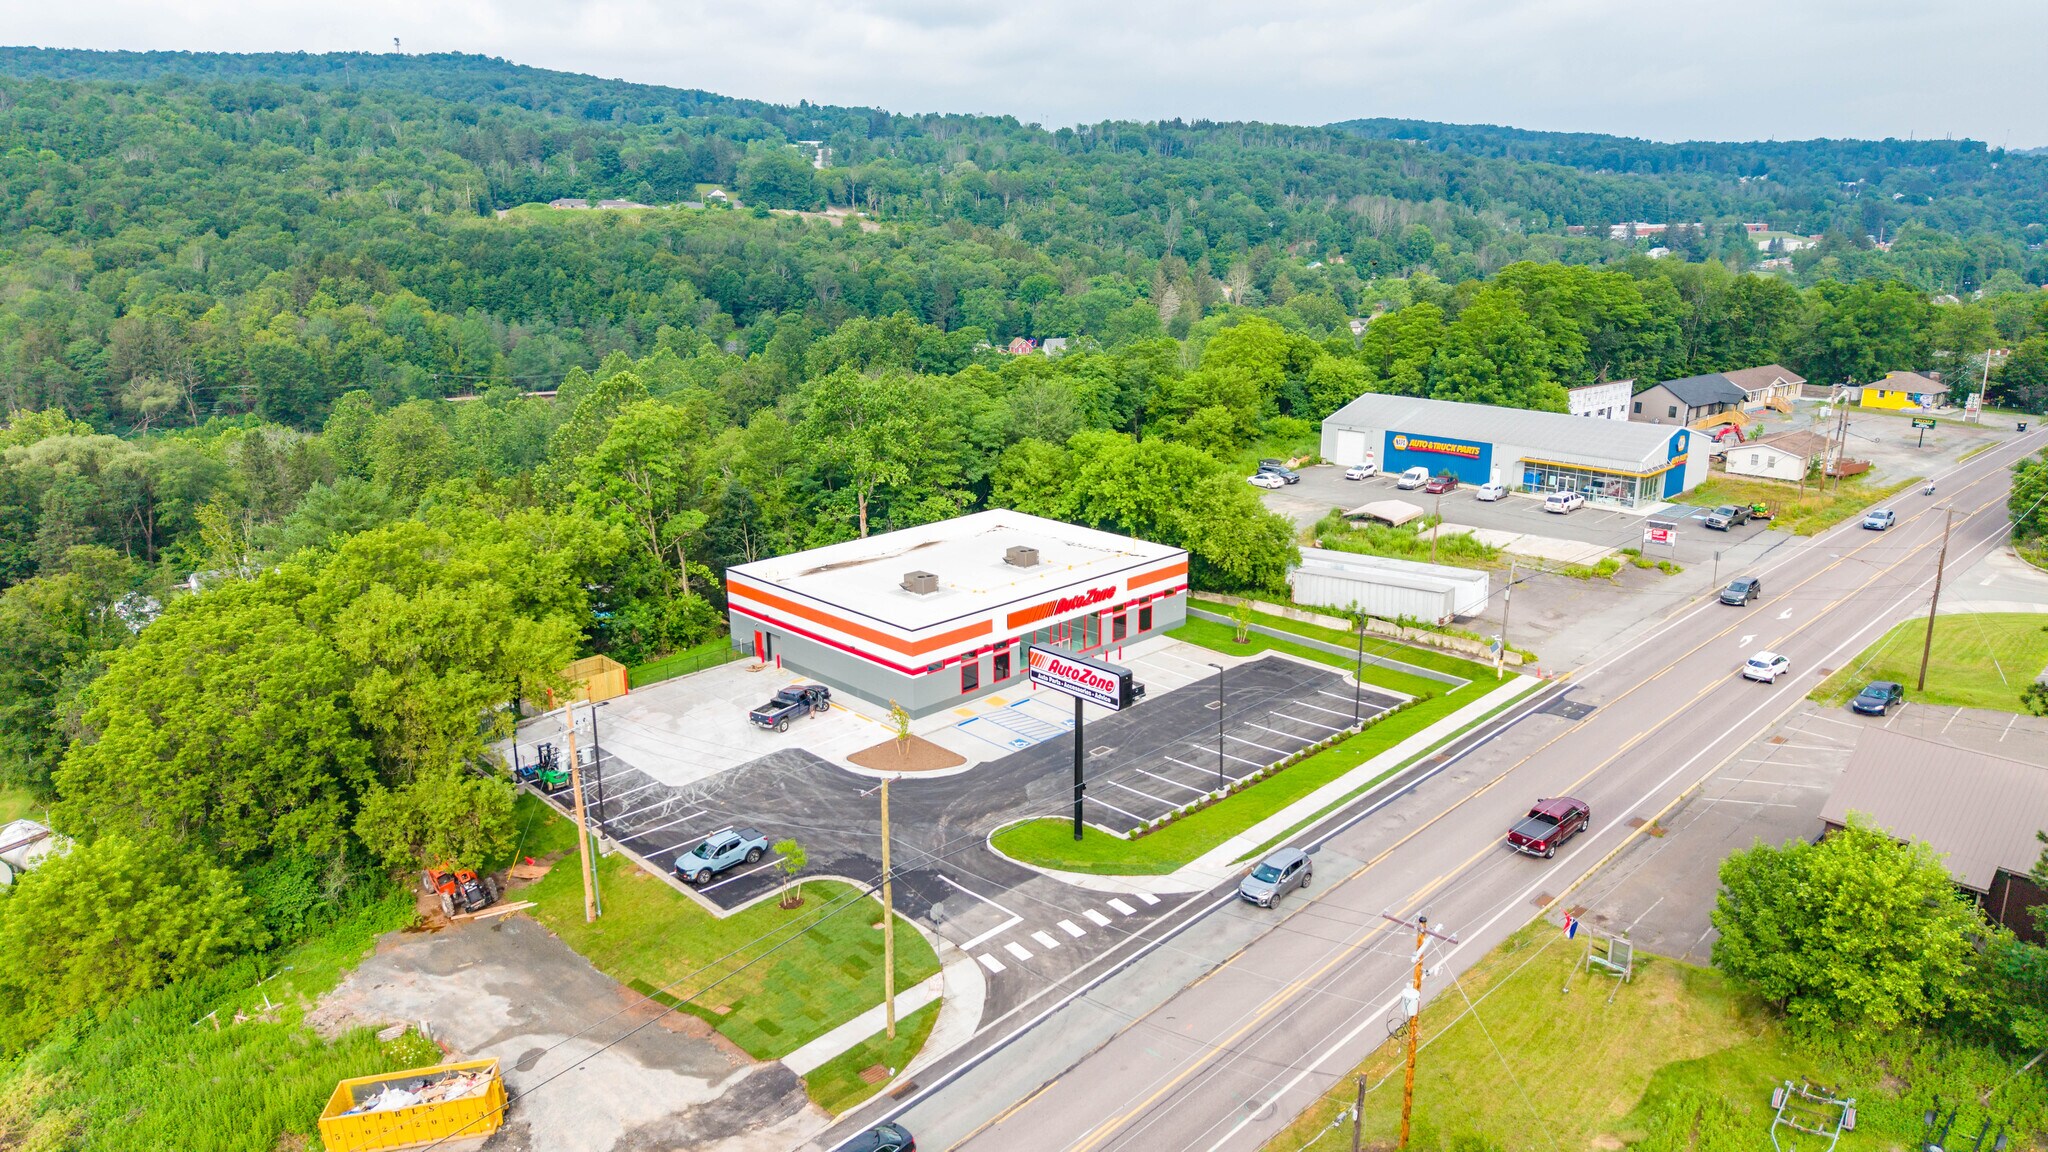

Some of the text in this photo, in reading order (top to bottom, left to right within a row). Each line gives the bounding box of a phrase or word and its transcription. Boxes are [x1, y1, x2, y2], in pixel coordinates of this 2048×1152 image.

[1409, 439, 1428, 448] AUTO
[1434, 443, 1456, 452] TRUCK
[1457, 446, 1480, 455] PARTS
[1054, 586, 1116, 615] AutoZone
[1037, 673, 1112, 703] Auto Parts Accessories Advice
[1048, 659, 1115, 693] AutoZone
[362, 1105, 435, 1122] CARLS
